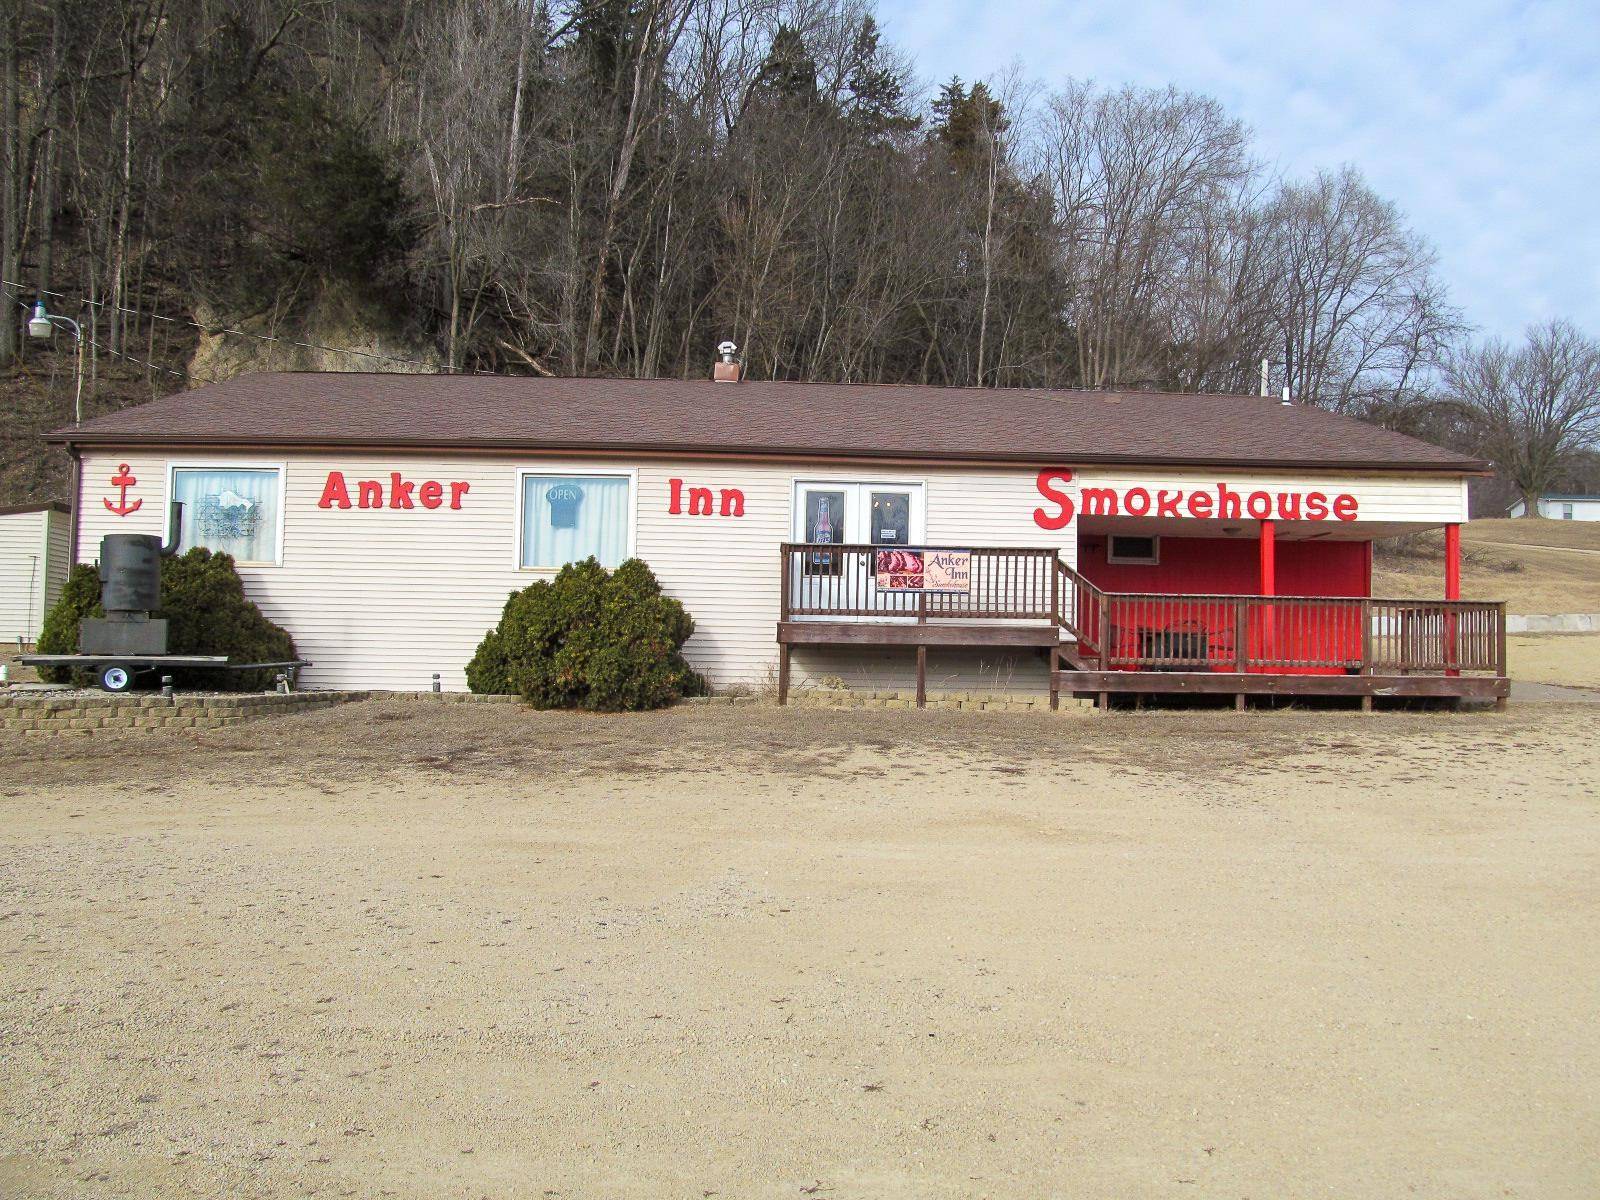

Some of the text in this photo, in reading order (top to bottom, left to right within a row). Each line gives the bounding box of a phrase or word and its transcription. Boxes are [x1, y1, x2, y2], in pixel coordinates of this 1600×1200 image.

[318, 470, 745, 517] Anker Inn
[549, 489, 577, 501] OPEN
[1033, 467, 1359, 530] Smokehouse
[928, 553, 968, 569] Anker
[945, 567, 968, 579] Inn
